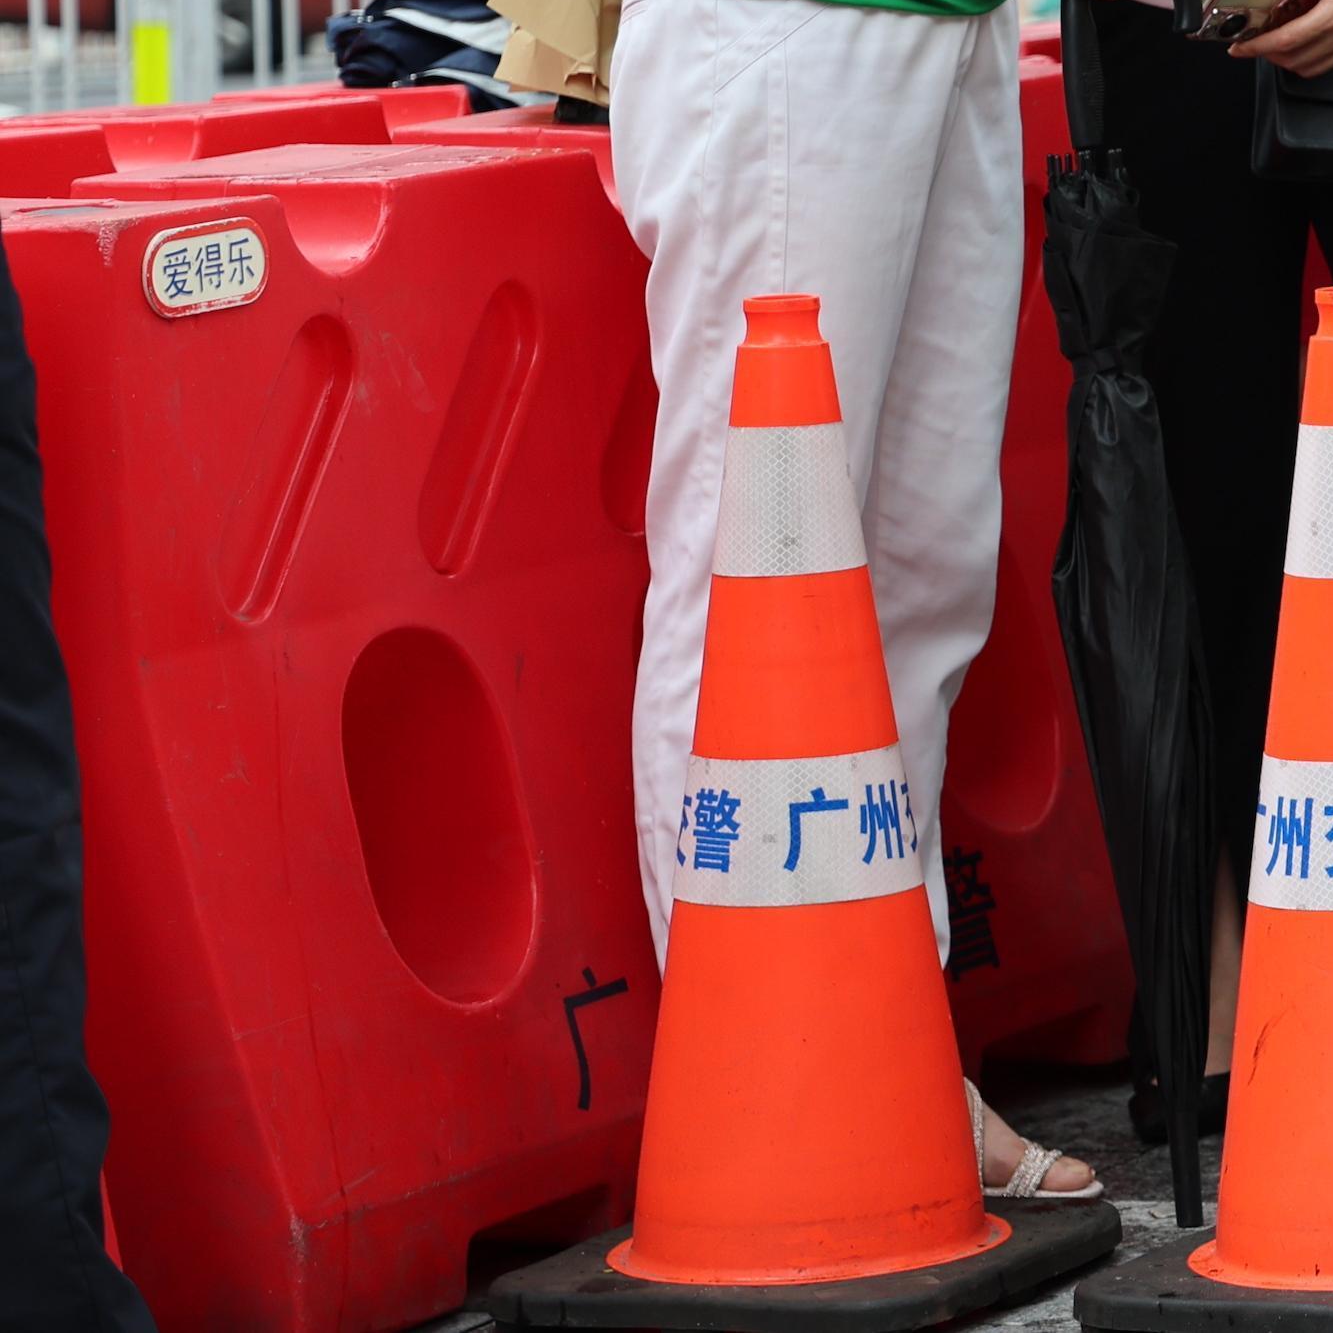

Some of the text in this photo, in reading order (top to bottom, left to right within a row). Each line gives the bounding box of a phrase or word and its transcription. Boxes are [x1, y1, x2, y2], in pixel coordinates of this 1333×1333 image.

[163, 237, 255, 299] 爱得乐
[563, 966, 630, 1111] 广
